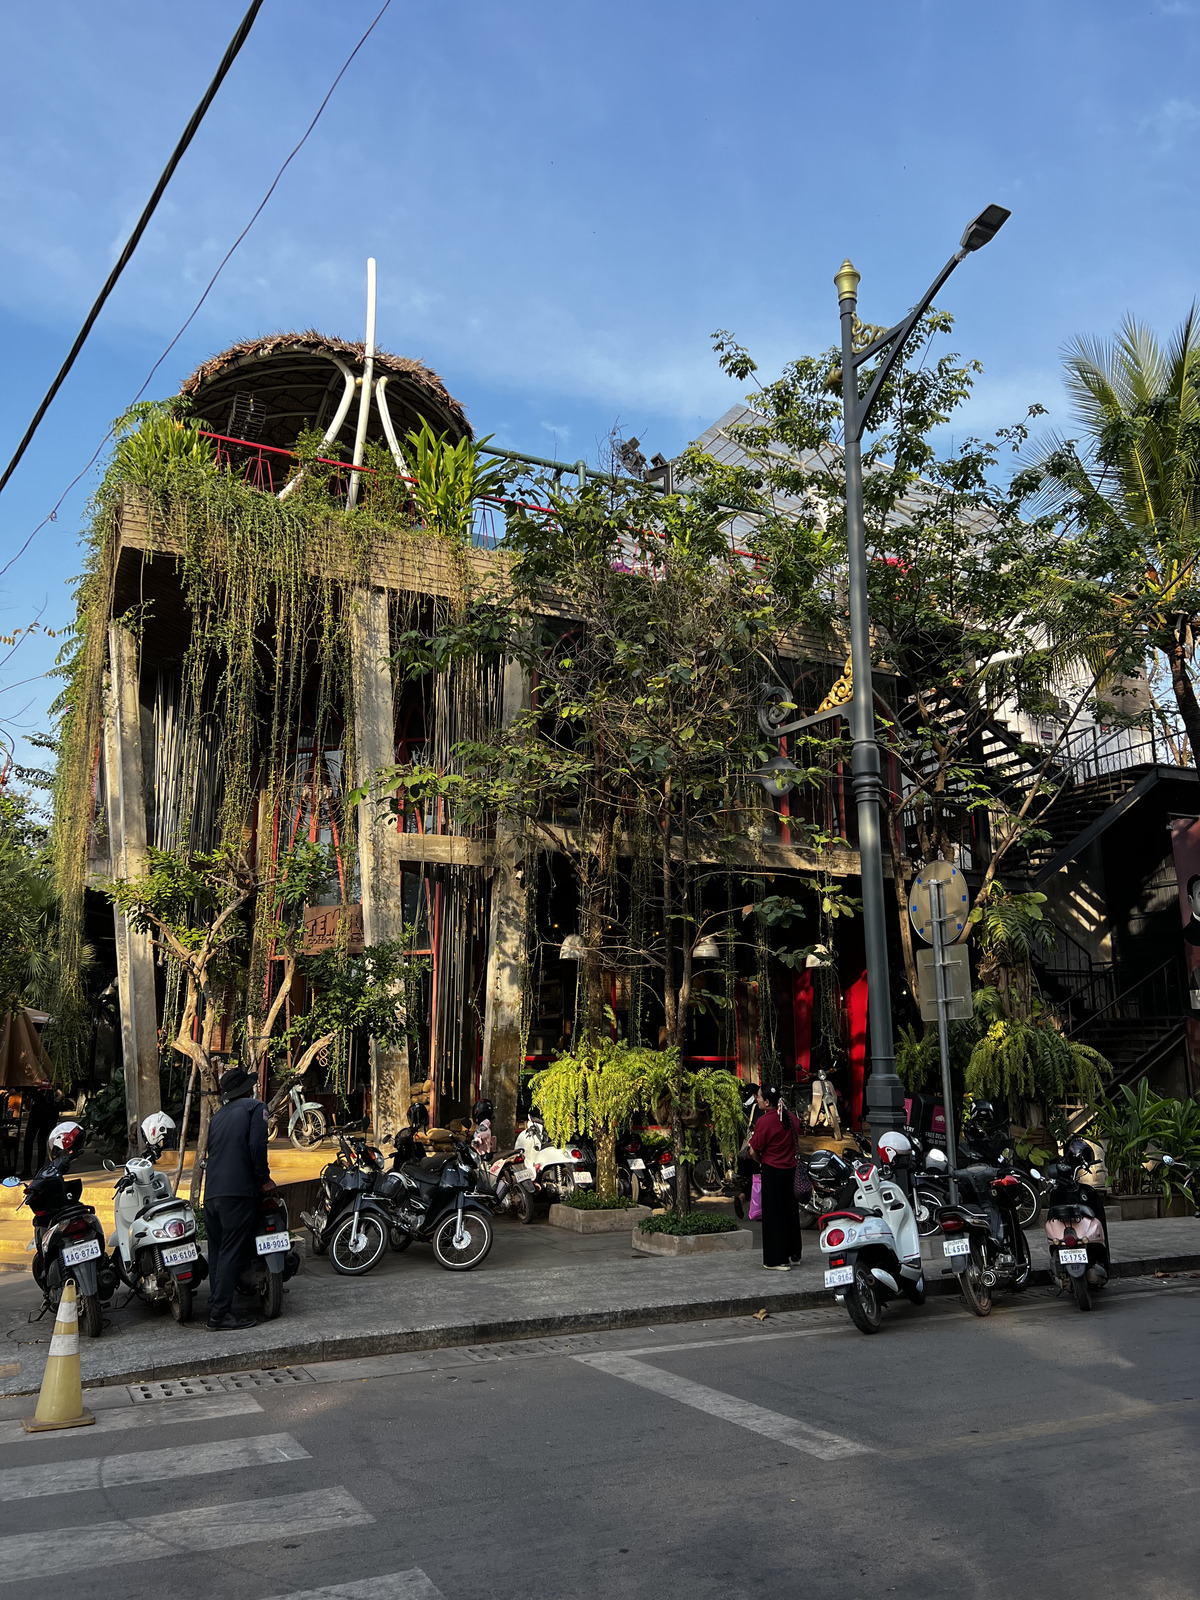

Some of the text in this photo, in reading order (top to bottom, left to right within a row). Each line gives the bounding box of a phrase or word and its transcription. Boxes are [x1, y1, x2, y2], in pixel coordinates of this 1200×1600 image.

[258, 1238, 289, 1251] 1AB-9013
[65, 1246, 99, 1263] 1AG-8743
[165, 1249, 197, 1263] 1AB-6106
